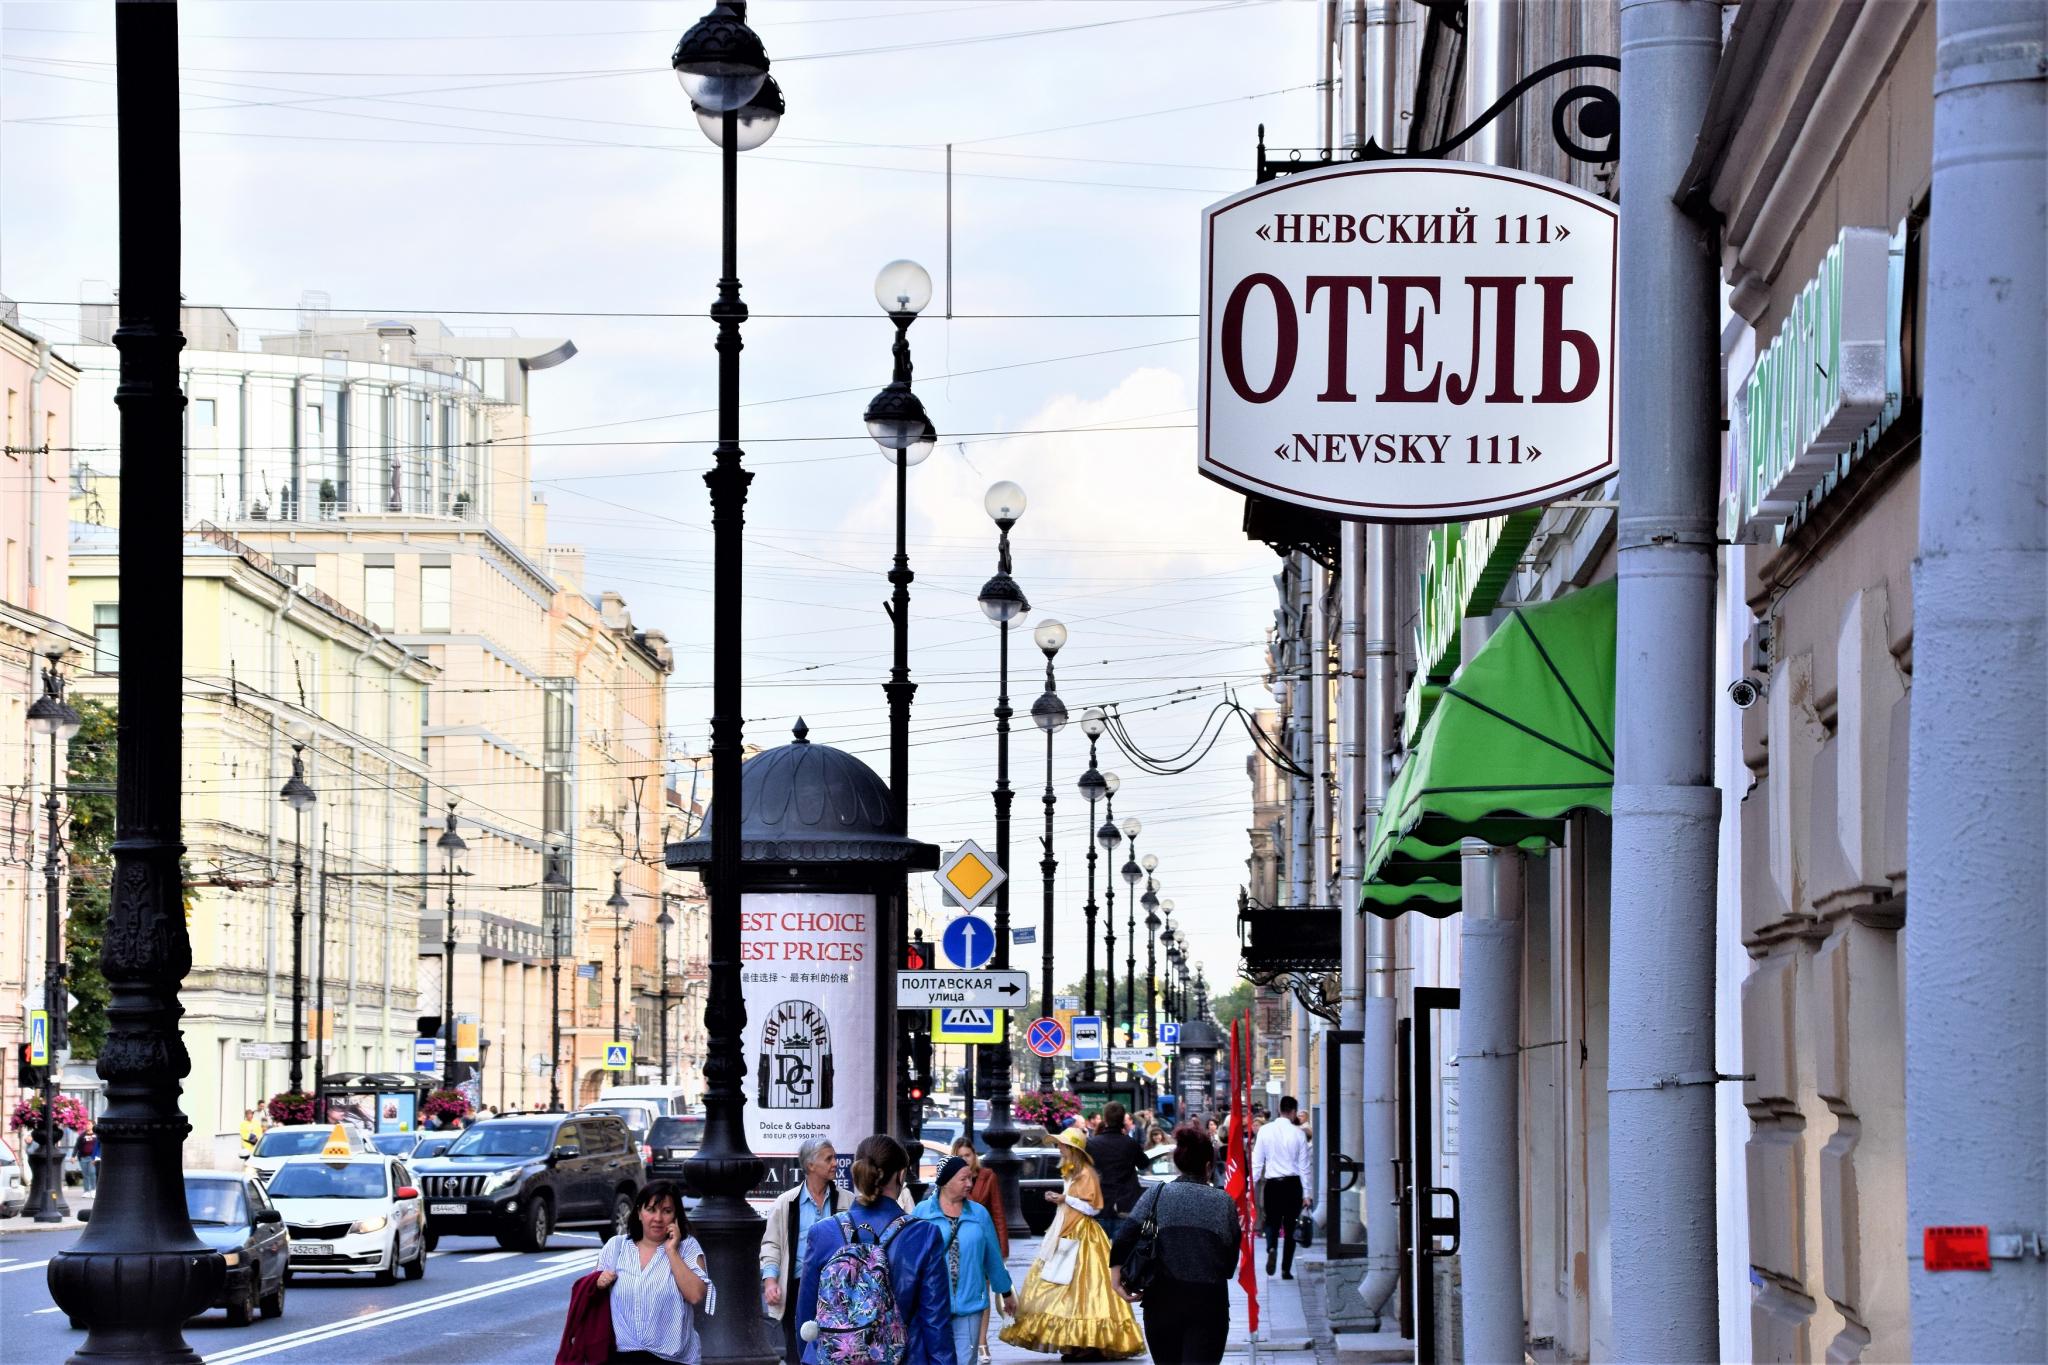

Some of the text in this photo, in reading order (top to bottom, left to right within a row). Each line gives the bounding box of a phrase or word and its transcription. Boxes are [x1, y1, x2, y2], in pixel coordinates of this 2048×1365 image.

[1255, 206, 1571, 244] «НЕВСКИЙ 111»
[1220, 272, 1601, 406] ОТЕЛЬ
[1273, 433, 1543, 465] «NEVSKY 111»
[740, 912, 866, 932] EST CHOICE
[740, 942, 864, 962] EST PRICES
[742, 972, 778, 983] 最佳选择
[789, 972, 849, 984] 最有利的价格
[901, 978, 992, 990] ПОЛТАВСКАЯ
[928, 993, 965, 1004] улица
[763, 1005, 828, 1046] ROYAL KING
[760, 1121, 831, 1131] Dolce & Gabbana
